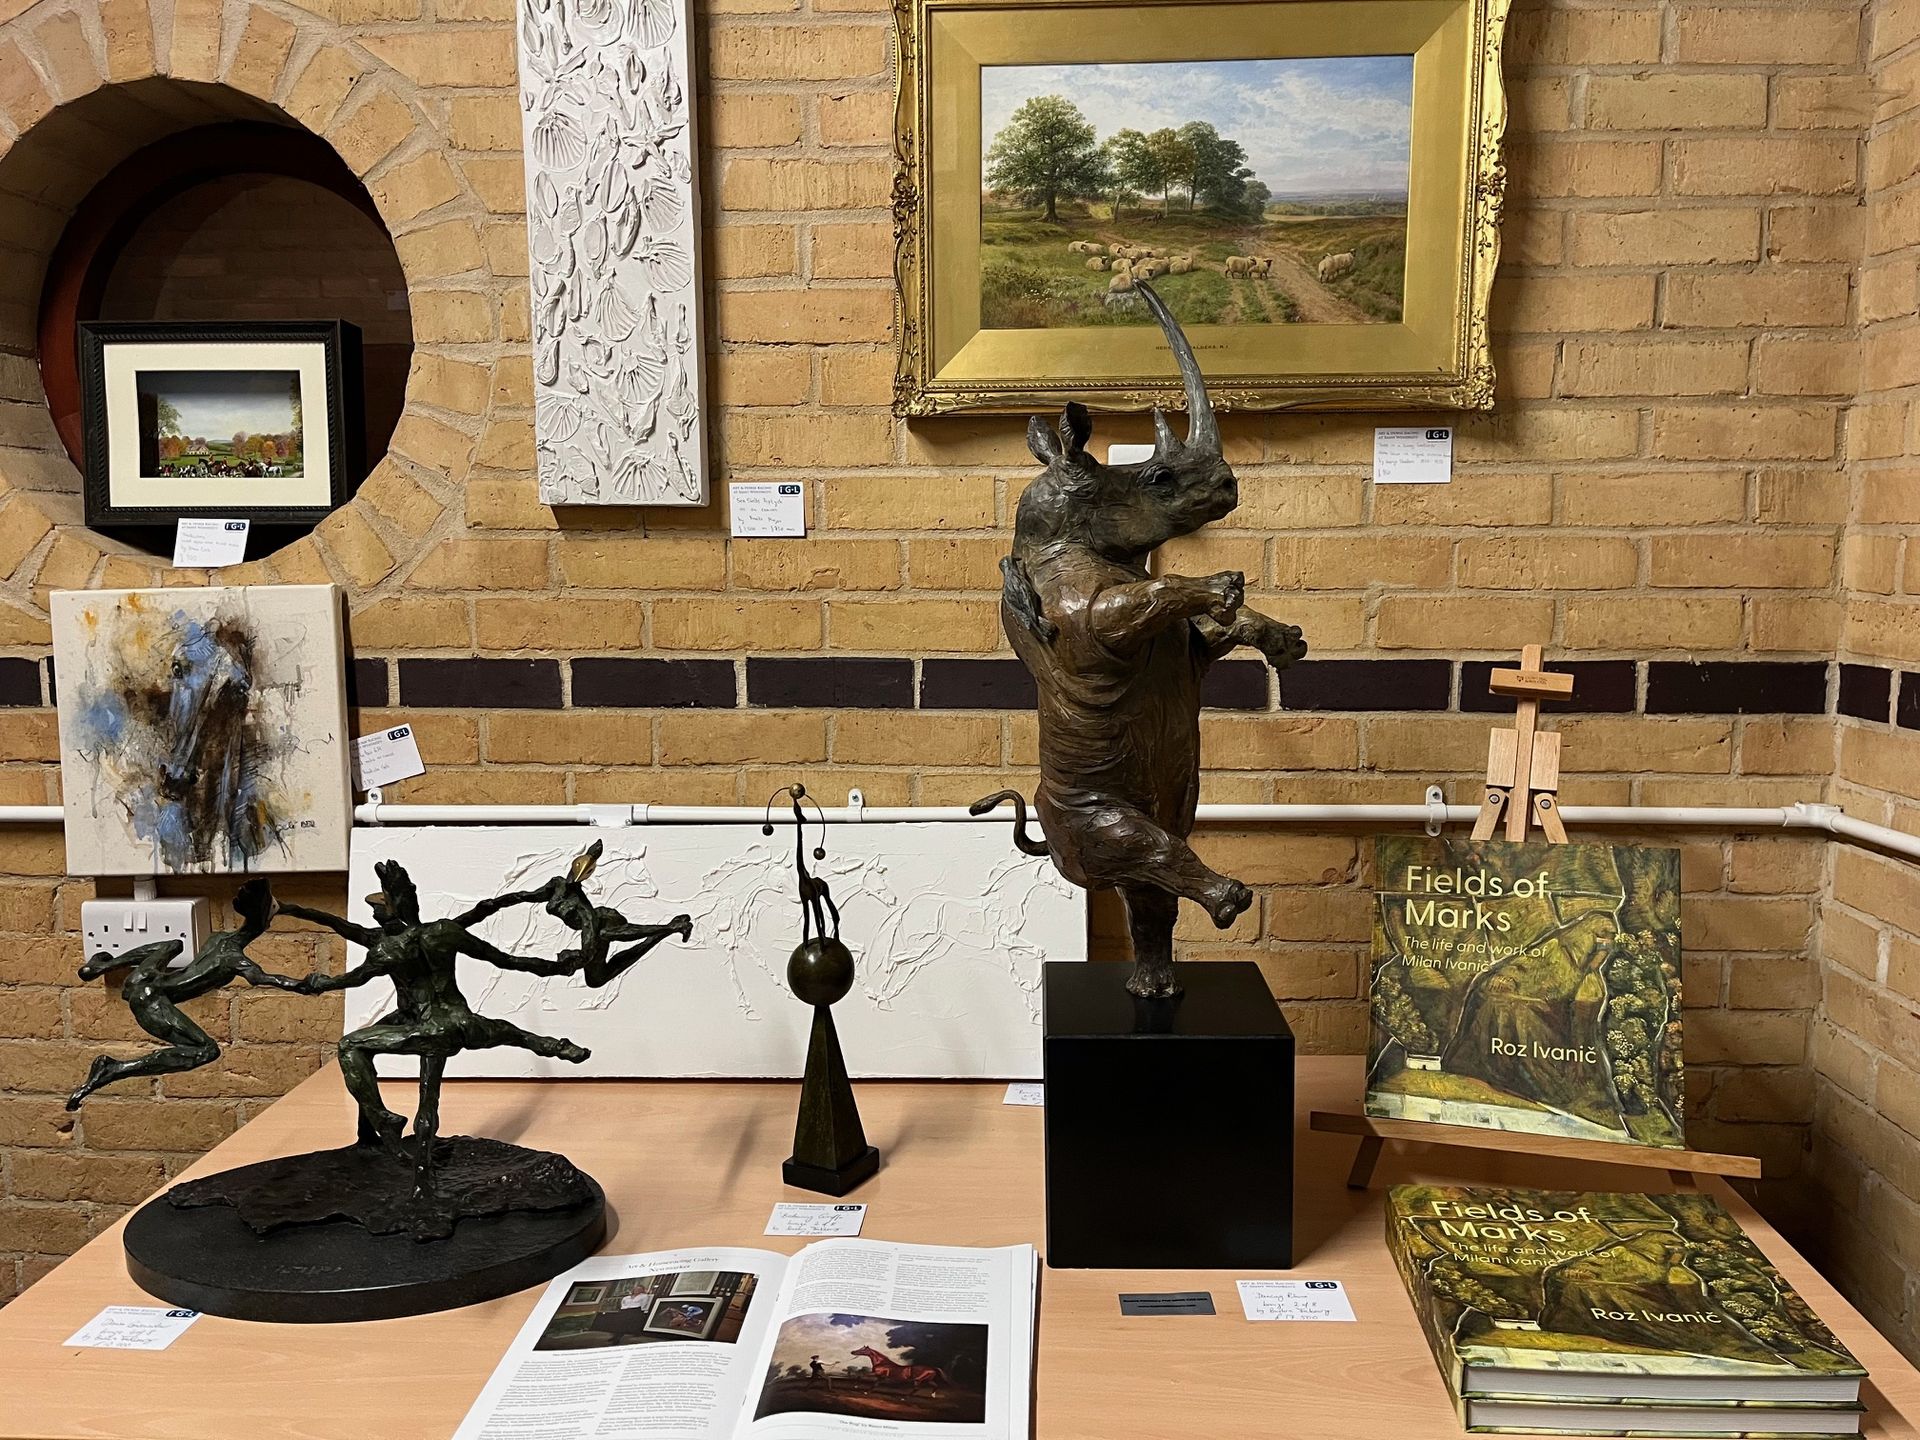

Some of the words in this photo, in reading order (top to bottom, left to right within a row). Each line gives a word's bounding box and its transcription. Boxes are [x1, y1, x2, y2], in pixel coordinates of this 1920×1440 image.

[1406, 865, 1503, 897] Fields
[1513, 871, 1549, 900] of
[1405, 899, 1512, 932] Marks
[1404, 936, 1429, 950] The
[1432, 937, 1453, 951] life
[1457, 941, 1488, 954] and
[1490, 944, 1528, 957] work
[1531, 946, 1549, 958] of
[1402, 955, 1442, 969] Milan
[1491, 1038, 1528, 1058] Roz
[1533, 1041, 1597, 1064] Ivanič
[1430, 1200, 1545, 1222] Fields
[1553, 1207, 1592, 1224] of
[1439, 1220, 1567, 1242] Marks
[1450, 1241, 1480, 1252] The
[1483, 1243, 1508, 1254] life
[1513, 1245, 1547, 1256] and
[1551, 1249, 1596, 1258] work
[1600, 1250, 1618, 1259] of
[1454, 1253, 1501, 1264] Milan
[650, 1264, 691, 1272] Newmarket
[1590, 1307, 1640, 1321] Roz
[1641, 1309, 1722, 1324] Ivanič
